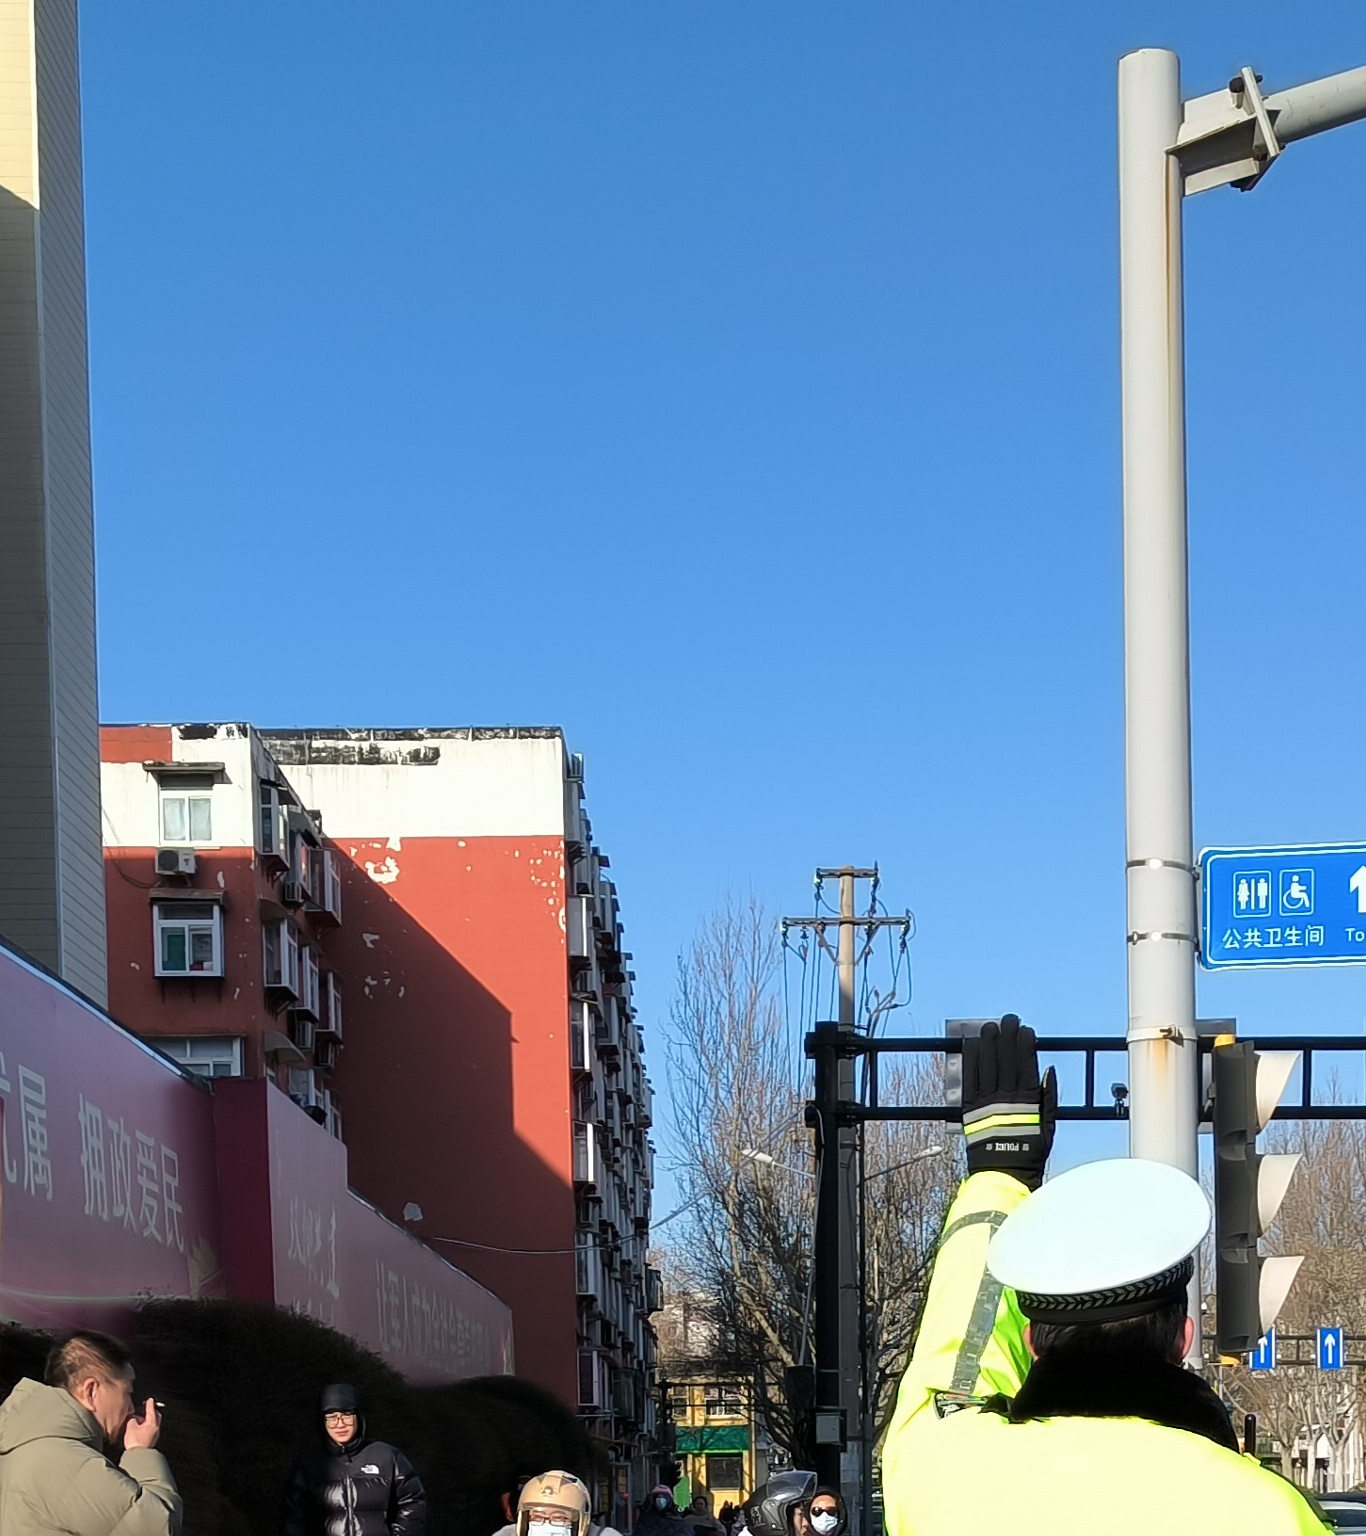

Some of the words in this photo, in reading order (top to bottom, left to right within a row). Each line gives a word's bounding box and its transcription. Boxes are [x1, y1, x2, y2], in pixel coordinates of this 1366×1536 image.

[1222, 924, 1325, 950] 公共卫生间
[77, 1092, 186, 1254] 拥政爱民
